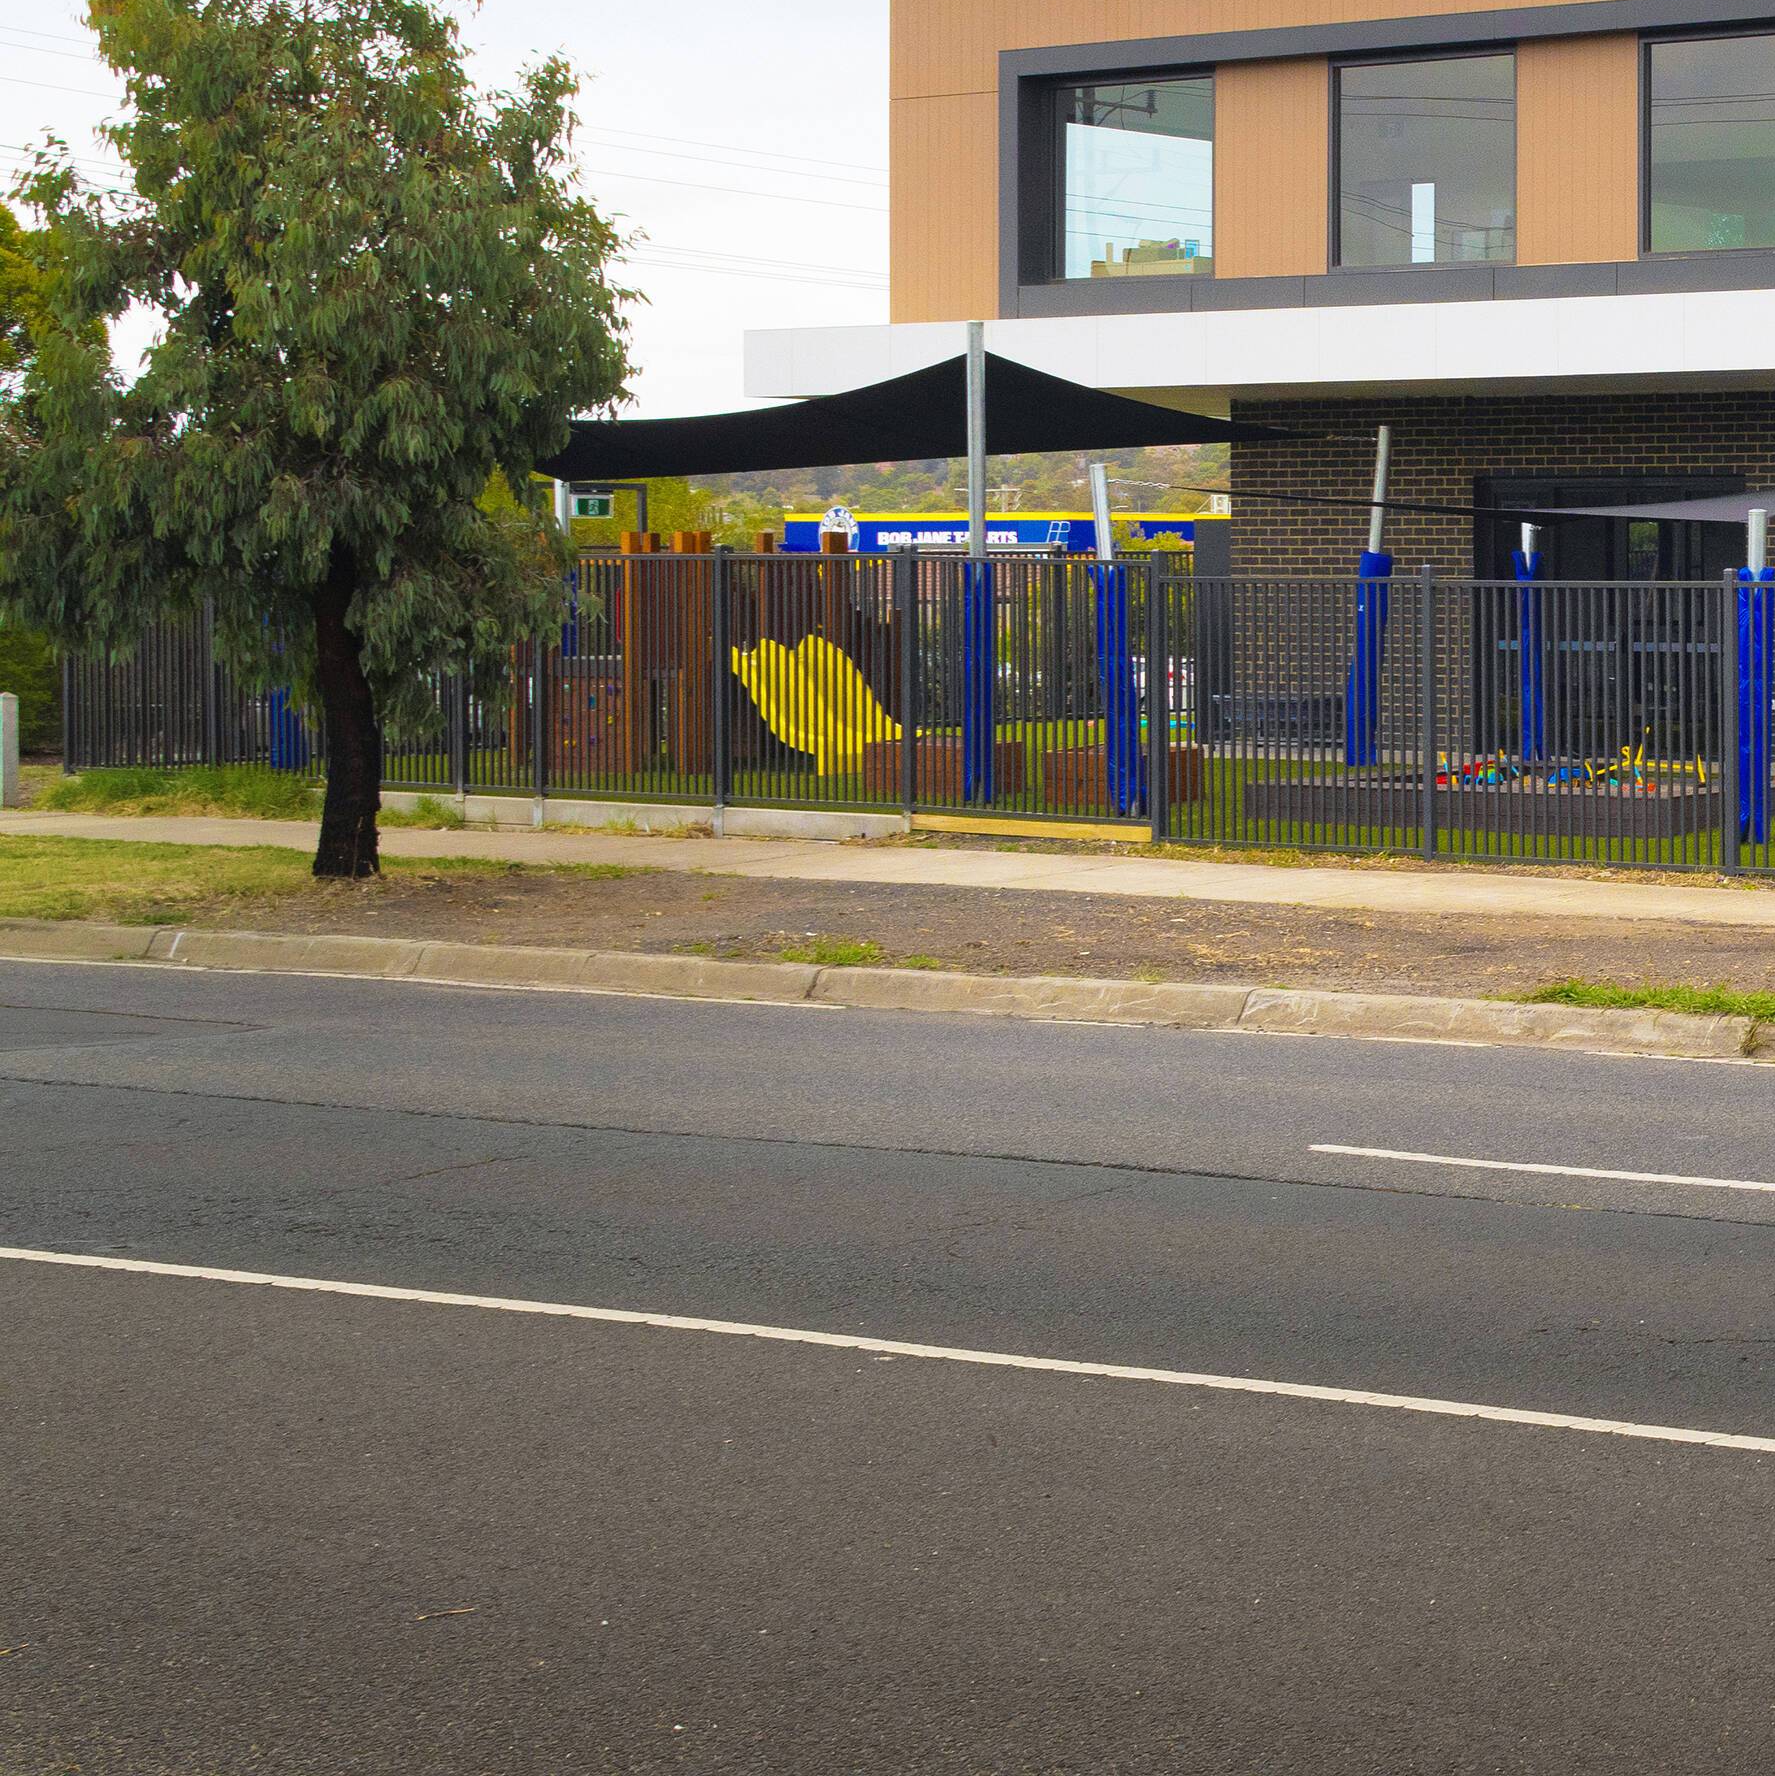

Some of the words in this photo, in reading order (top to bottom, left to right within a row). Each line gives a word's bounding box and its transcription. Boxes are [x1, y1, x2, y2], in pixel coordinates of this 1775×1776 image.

[877, 531, 912, 545] BOB
[912, 531, 951, 544] JANE
[954, 530, 1018, 544] T-ARTS
